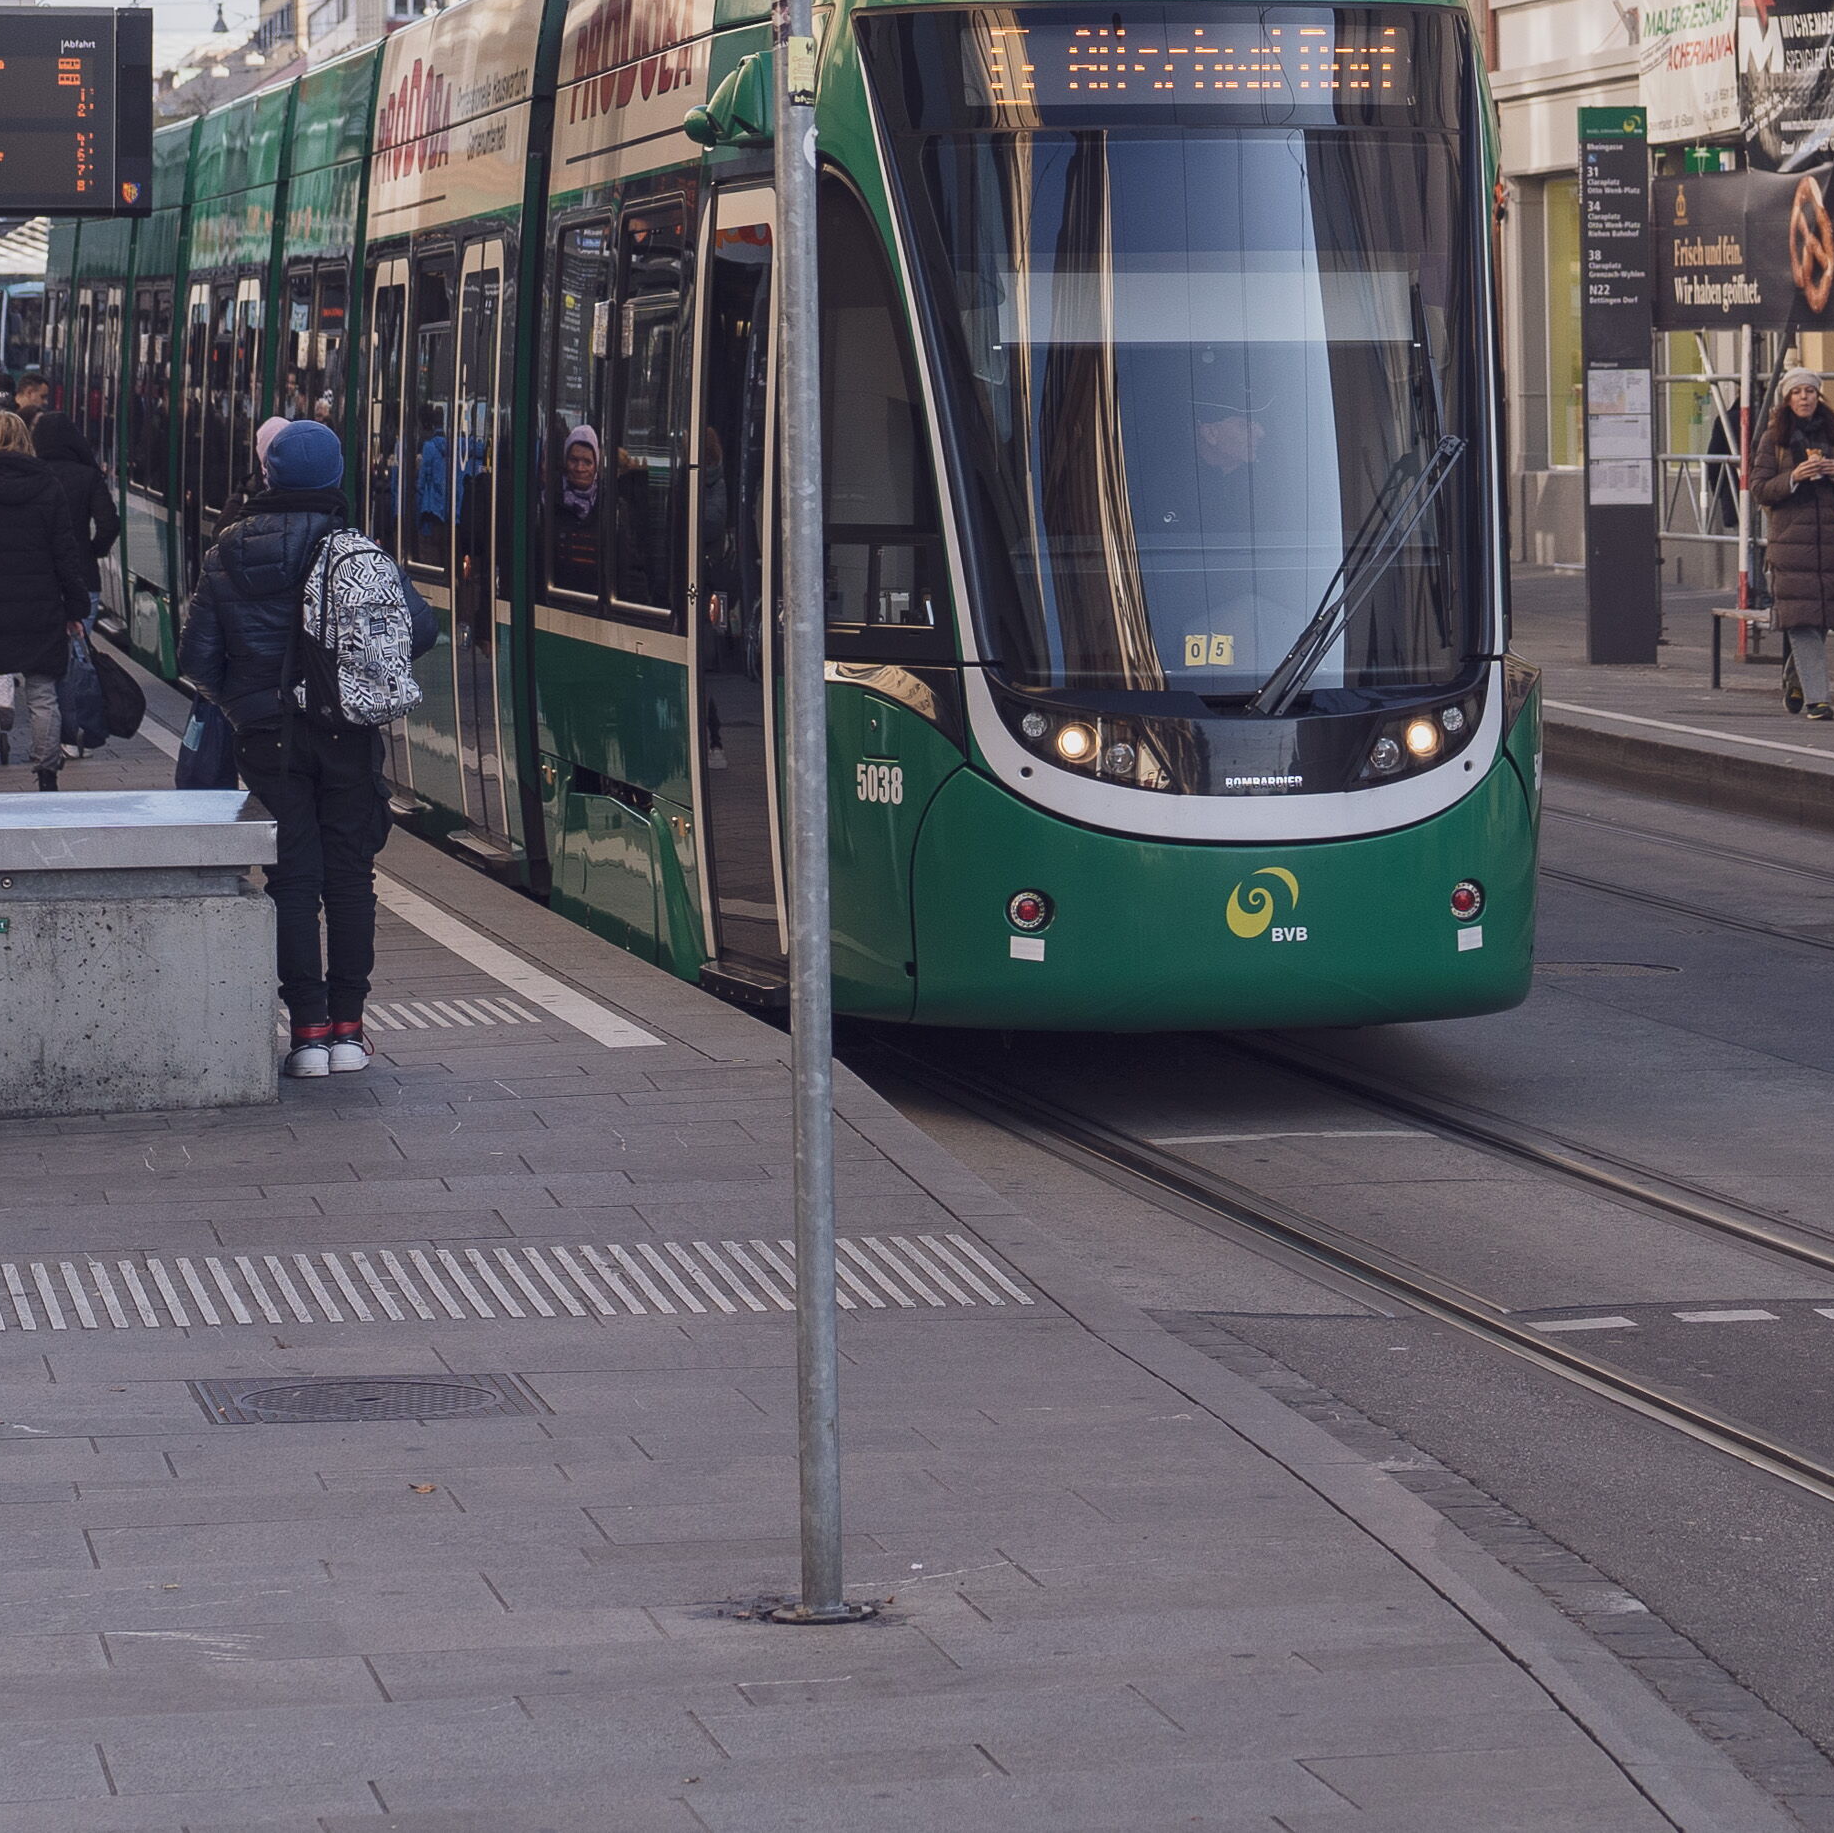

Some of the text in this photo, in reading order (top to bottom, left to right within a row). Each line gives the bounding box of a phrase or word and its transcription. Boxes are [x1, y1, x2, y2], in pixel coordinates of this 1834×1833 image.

[63, 40, 96, 50] Abfahrt
[373, 57, 452, 188] PRODOBA
[1586, 167, 1599, 177] 31
[1587, 201, 1601, 212] 34
[1588, 250, 1602, 261] 38
[1674, 235, 1743, 267] Frisch und fein.
[1589, 285, 1611, 296] N22
[1674, 273, 1762, 313] Wir haben geöffnet.
[856, 763, 904, 805] 5038
[1224, 775, 1303, 790] BOMBARDIER
[1271, 926, 1308, 941] BVB
